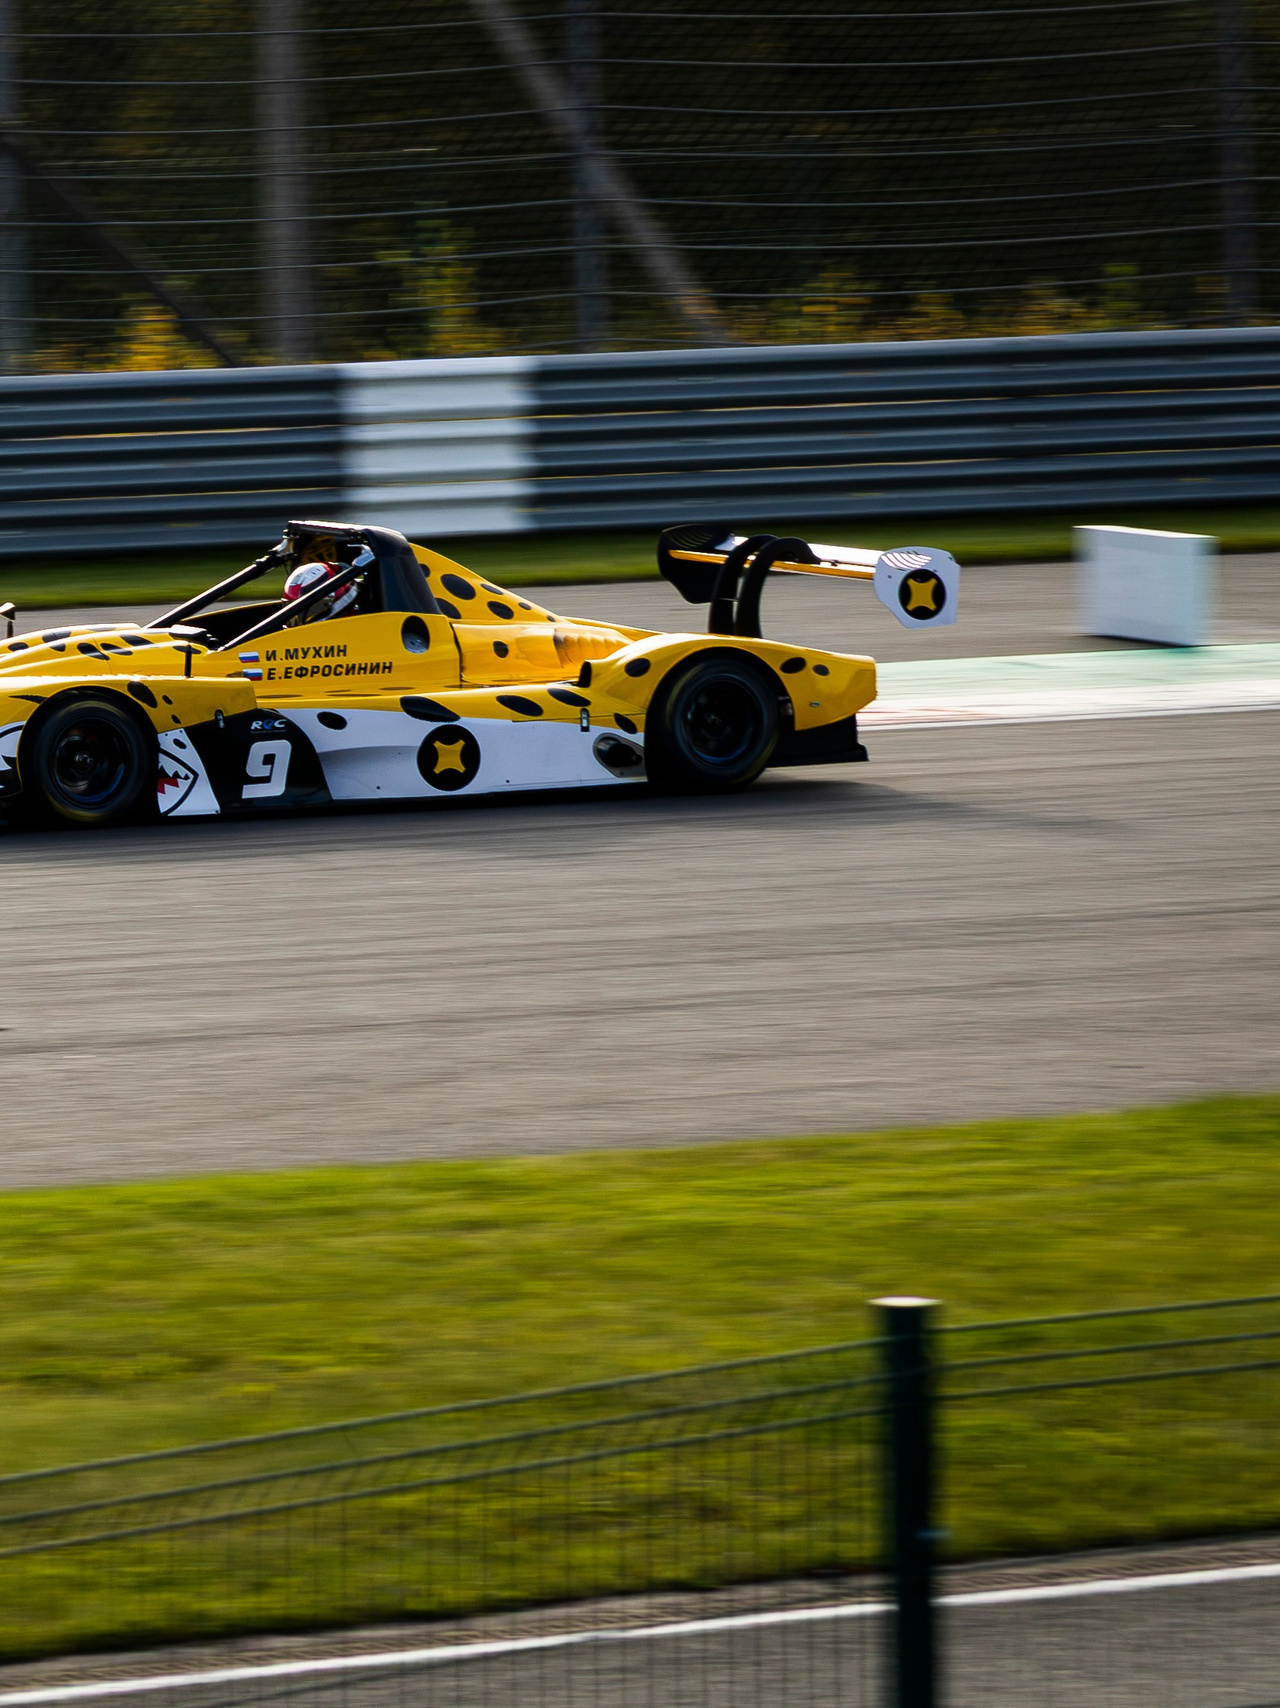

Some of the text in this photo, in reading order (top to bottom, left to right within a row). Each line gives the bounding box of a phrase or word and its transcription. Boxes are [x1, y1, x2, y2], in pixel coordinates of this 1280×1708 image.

[265, 644, 347, 662] И.МУХИН
[266, 661, 393, 681] Е.ЕФРОСИНИН
[241, 739, 292, 799] 9
